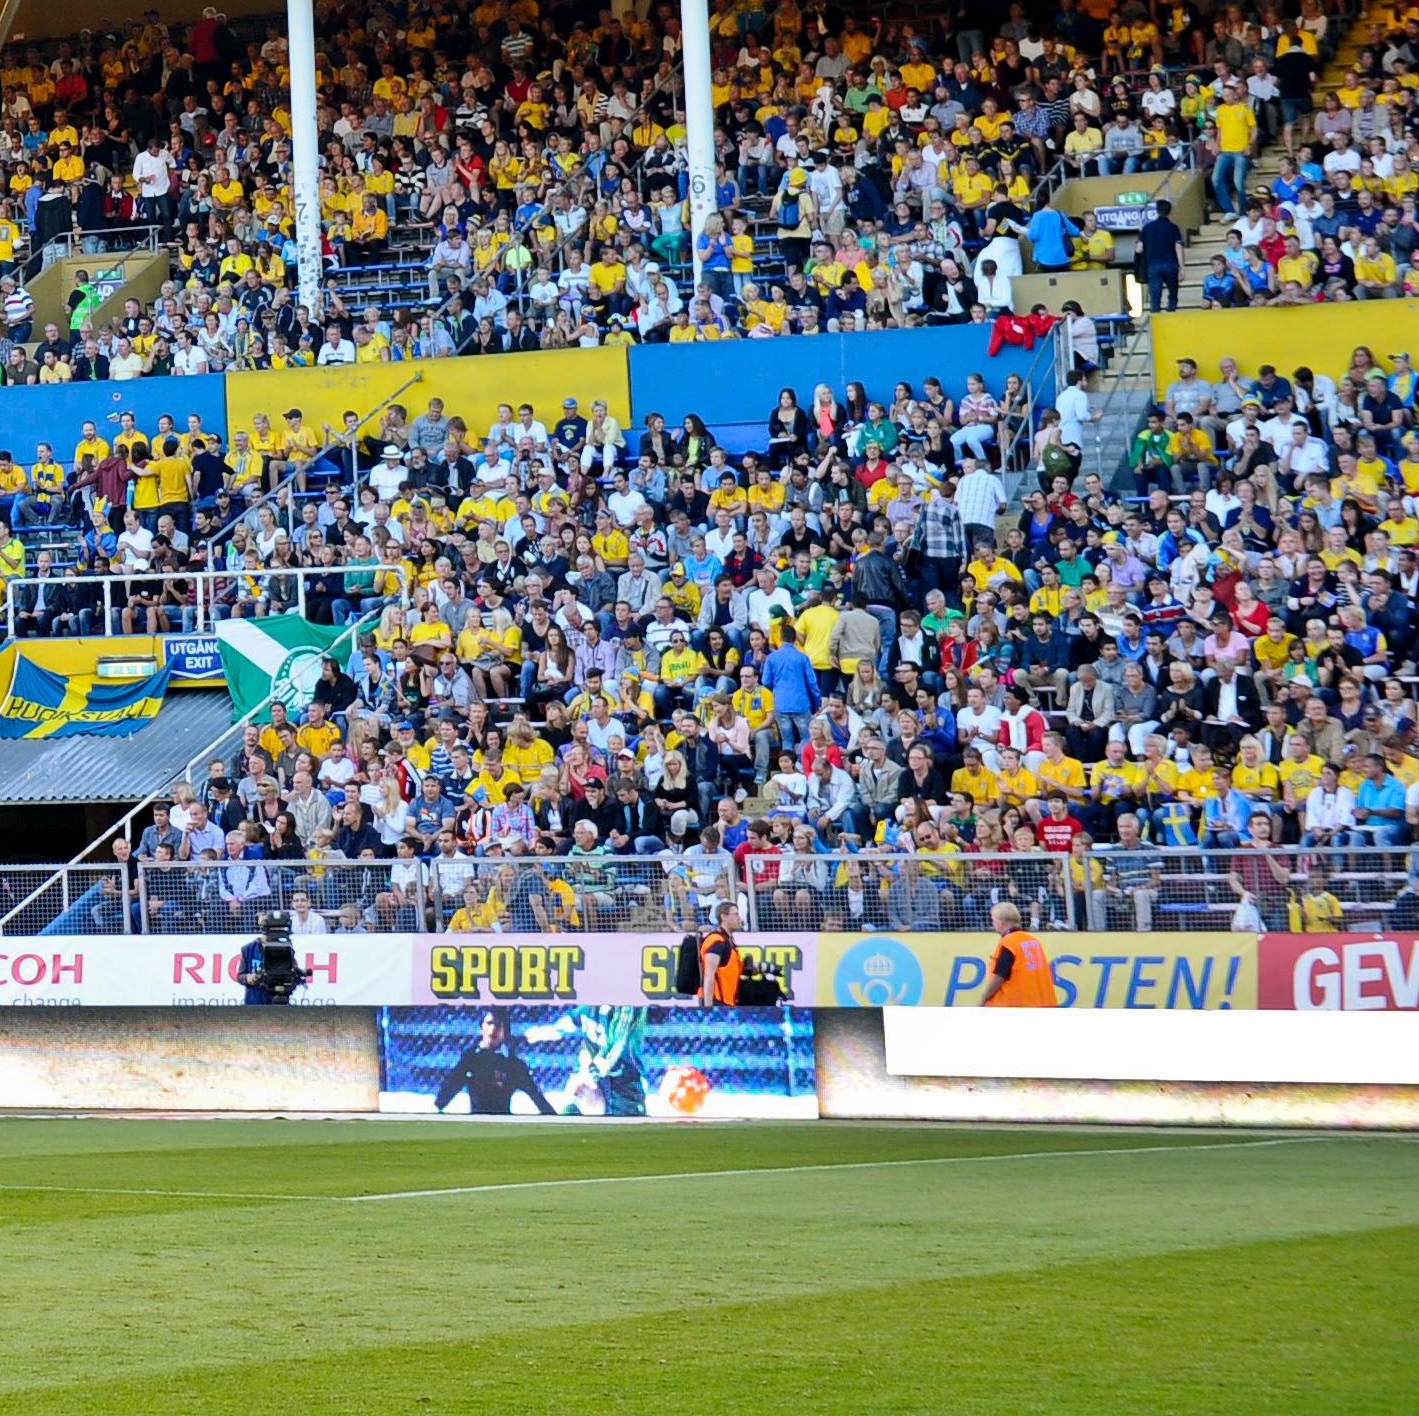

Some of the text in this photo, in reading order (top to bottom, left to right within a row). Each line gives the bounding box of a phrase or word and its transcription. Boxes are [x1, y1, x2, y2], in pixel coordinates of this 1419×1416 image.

[692, 174, 706, 195] 6
[296, 202, 307, 223] 7
[185, 656, 213, 669] EXIT
[174, 952, 337, 984] RIH
[430, 945, 583, 1001] SPORT
[943, 956, 1241, 1009] PSTEN!
